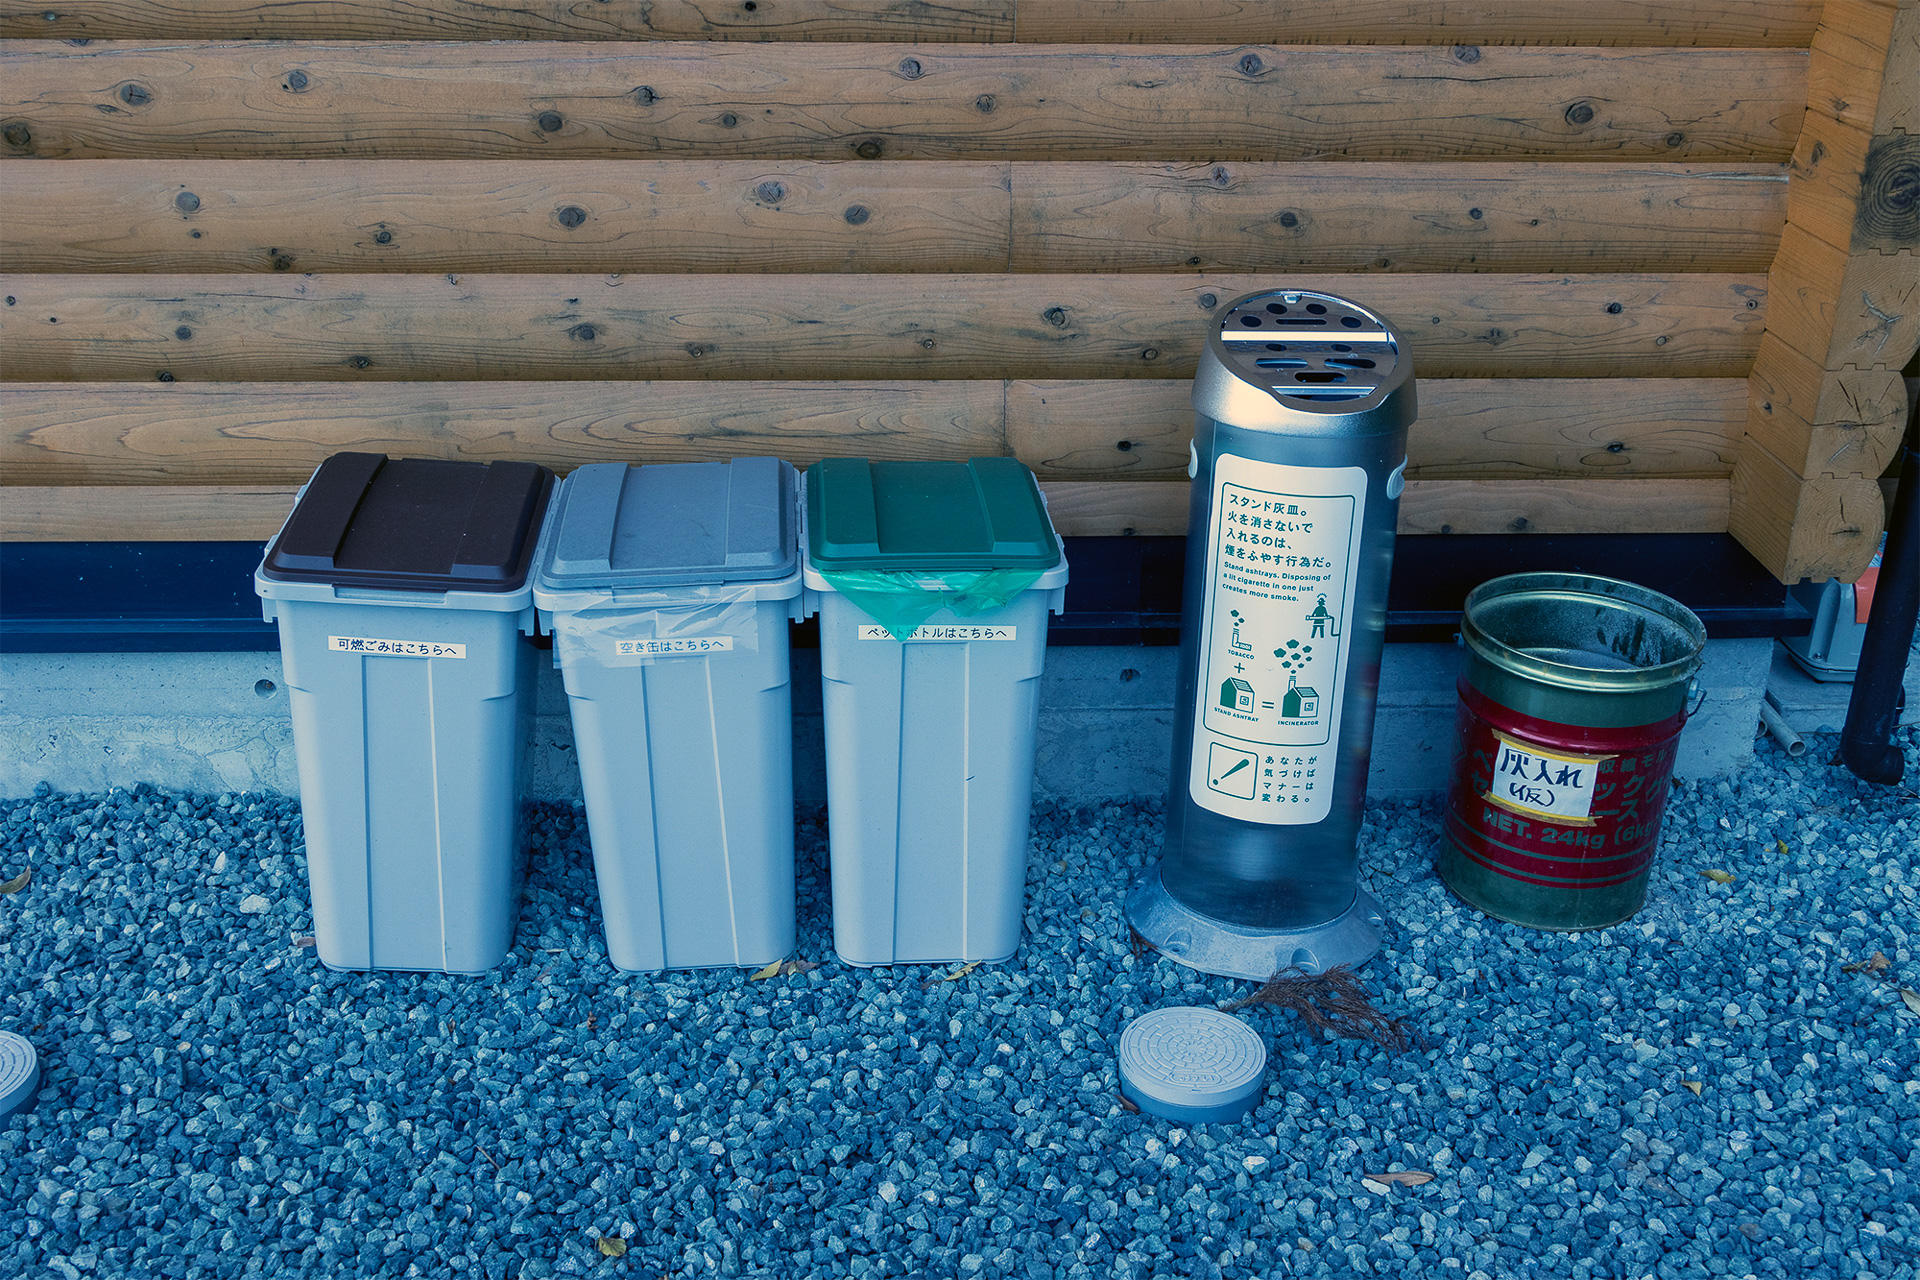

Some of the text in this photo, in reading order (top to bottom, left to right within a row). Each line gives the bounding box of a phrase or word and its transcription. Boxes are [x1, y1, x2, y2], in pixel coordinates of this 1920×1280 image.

[1229, 493, 1307, 517] スタンド灰皿。
[1227, 510, 1314, 533] 火を消さないで
[1226, 527, 1292, 550] 入れるのは、
[1224, 543, 1332, 568] 煙をふやす行為だ。
[1224, 561, 1244, 572] Stand
[1245, 567, 1280, 579] ashtrays.
[1281, 572, 1321, 582] Disposing
[1228, 573, 1236, 581] lit
[1237, 576, 1270, 589] cigarette
[1222, 582, 1299, 602] creates more smoke.
[867, 627, 1007, 639] ペットボトルはこちらへ
[337, 637, 457, 655] 可燃ごみはこちらへ
[619, 639, 725, 654] 空き缶はこちらへ
[1227, 649, 1255, 660] TOBACCO
[1214, 706, 1260, 723] STAND ASHTRAY
[1277, 719, 1319, 727] INCINERATOR
[1264, 755, 1318, 766] あなたが
[1499, 747, 1584, 789] 灰入れ
[1263, 768, 1316, 779] 気づけば
[1263, 781, 1314, 791] マナーは
[1261, 793, 1310, 803] 変わる。
[1483, 807, 1532, 839] NET.
[1541, 827, 1605, 849] 24kg
